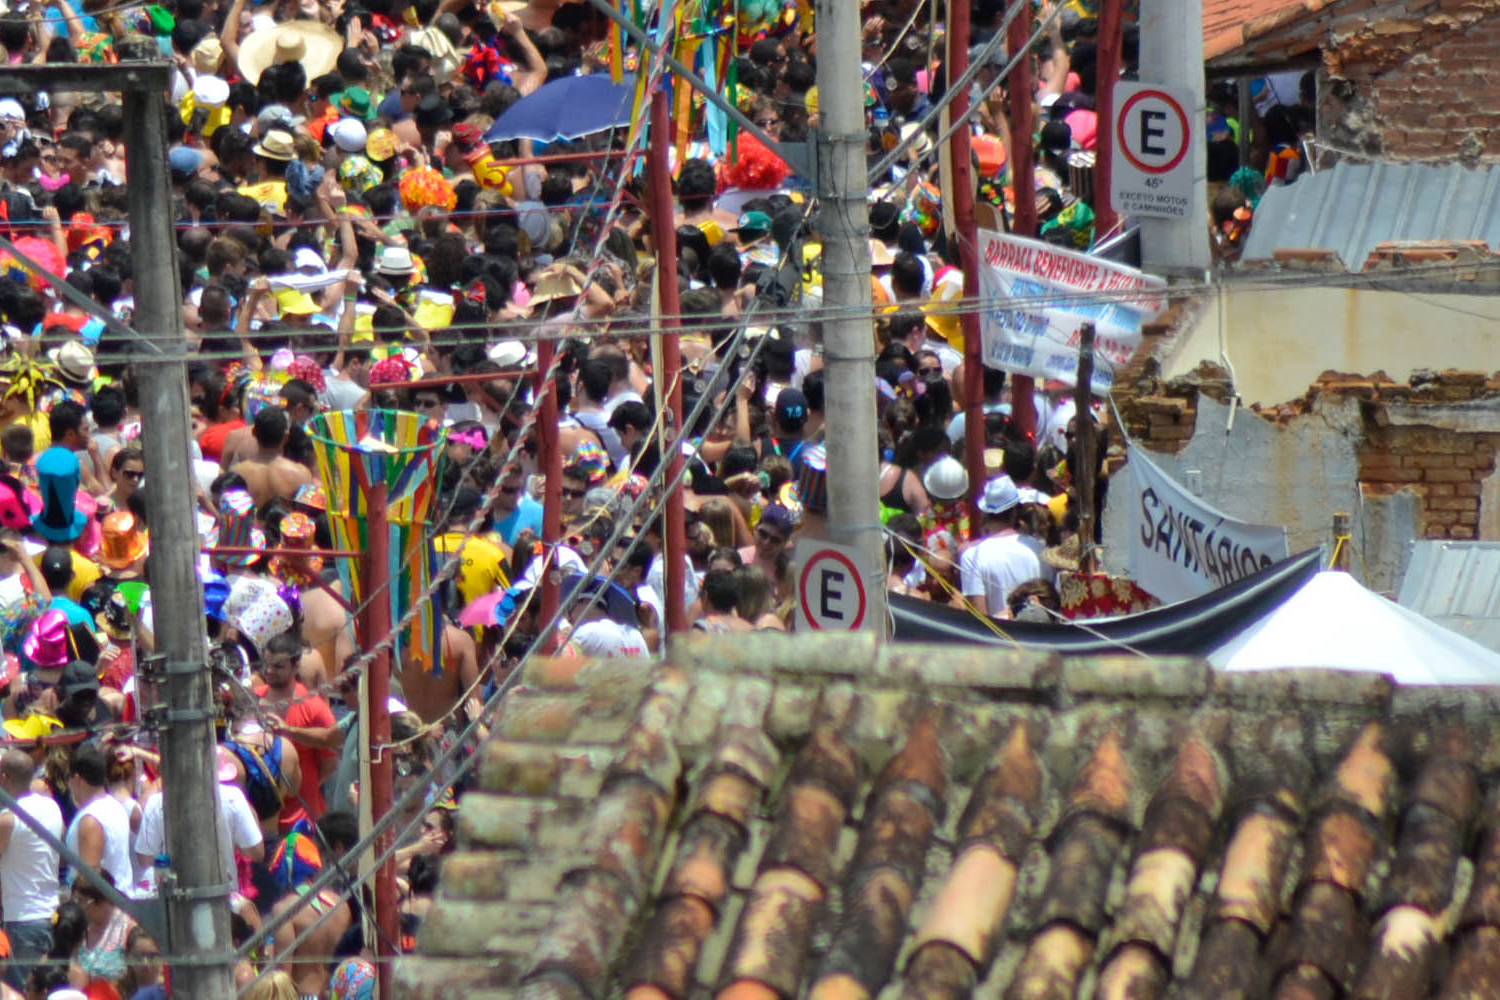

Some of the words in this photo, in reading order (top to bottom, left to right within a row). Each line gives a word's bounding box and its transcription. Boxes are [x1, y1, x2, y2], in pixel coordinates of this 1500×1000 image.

[1141, 109, 1167, 156] E
[1119, 191, 1154, 202] EXCETO
[1156, 195, 1188, 206] MOTOS
[985, 239, 1032, 273] BARRACA
[1032, 249, 1099, 291] BENEFICENTE
[821, 568, 845, 620] E
